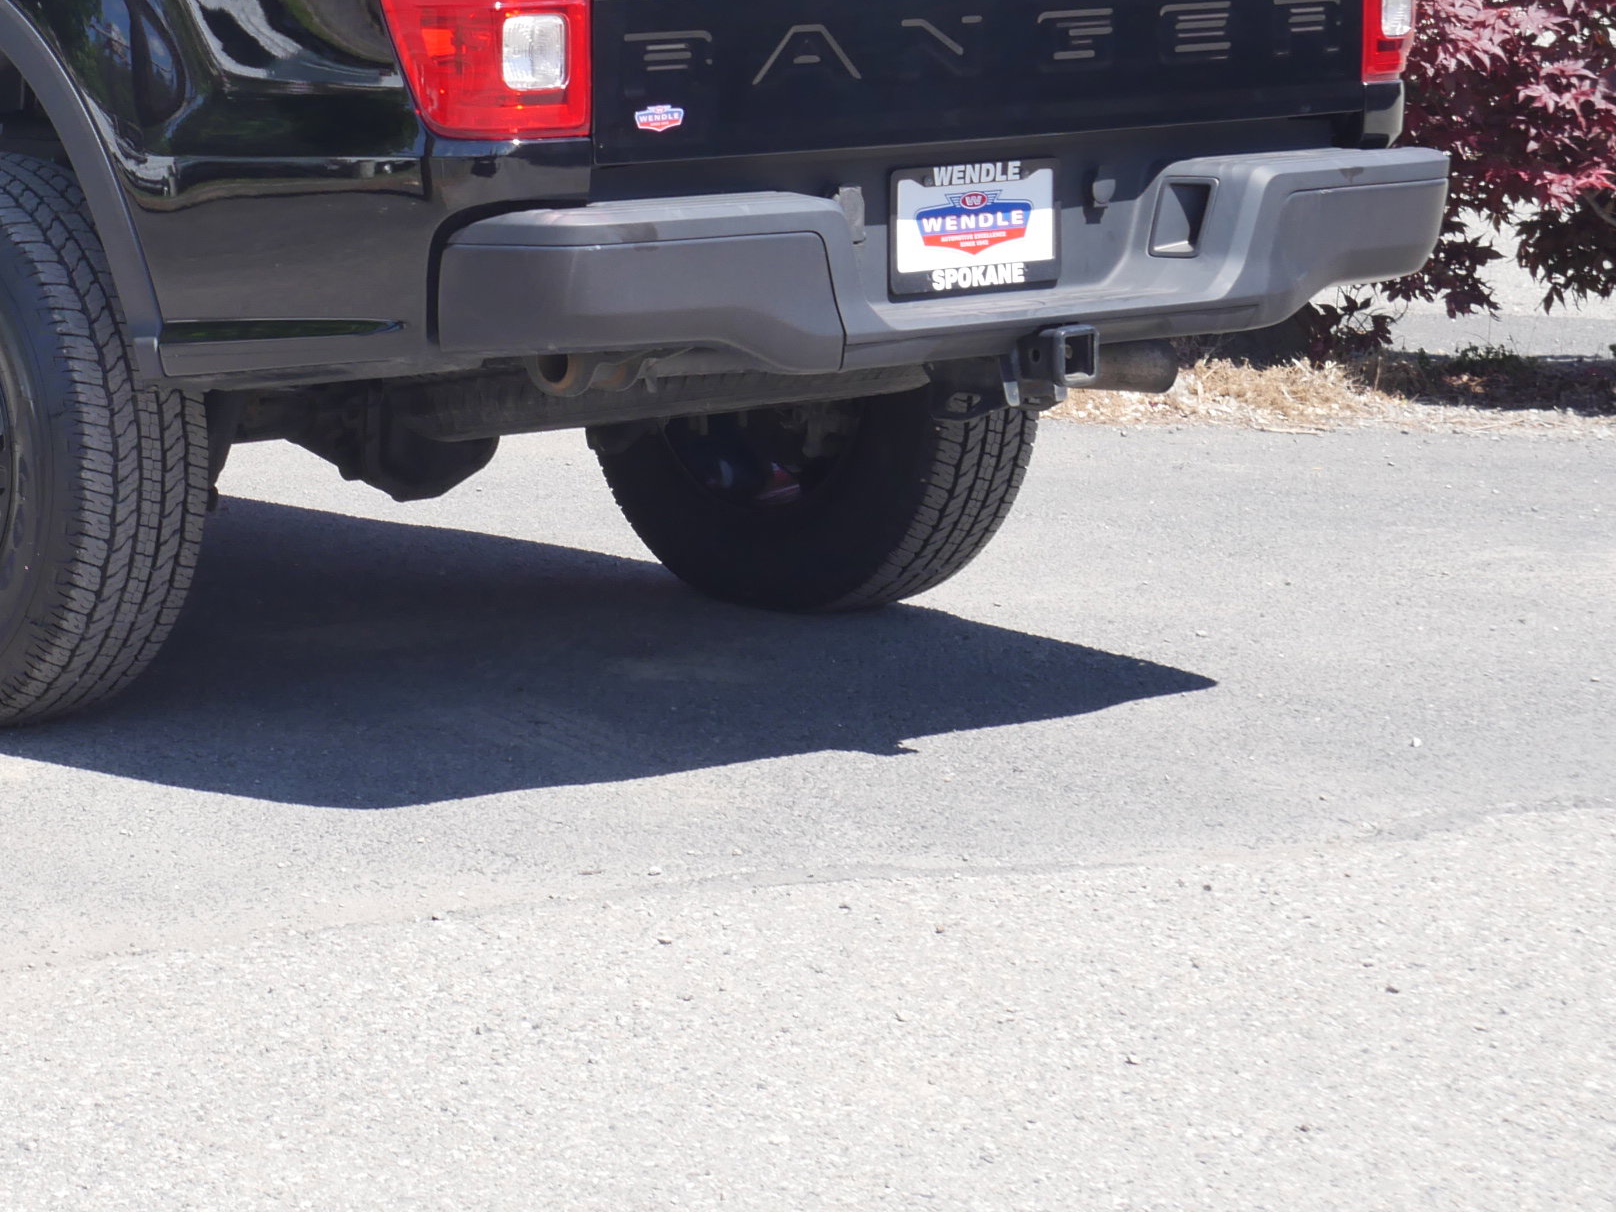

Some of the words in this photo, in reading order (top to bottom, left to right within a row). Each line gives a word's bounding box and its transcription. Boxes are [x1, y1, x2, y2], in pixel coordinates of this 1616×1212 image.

[639, 113, 680, 122] WENDLE
[933, 161, 1022, 186] WENDLE
[922, 210, 1025, 233] WENDLE
[932, 262, 1026, 291] SPOKANE
